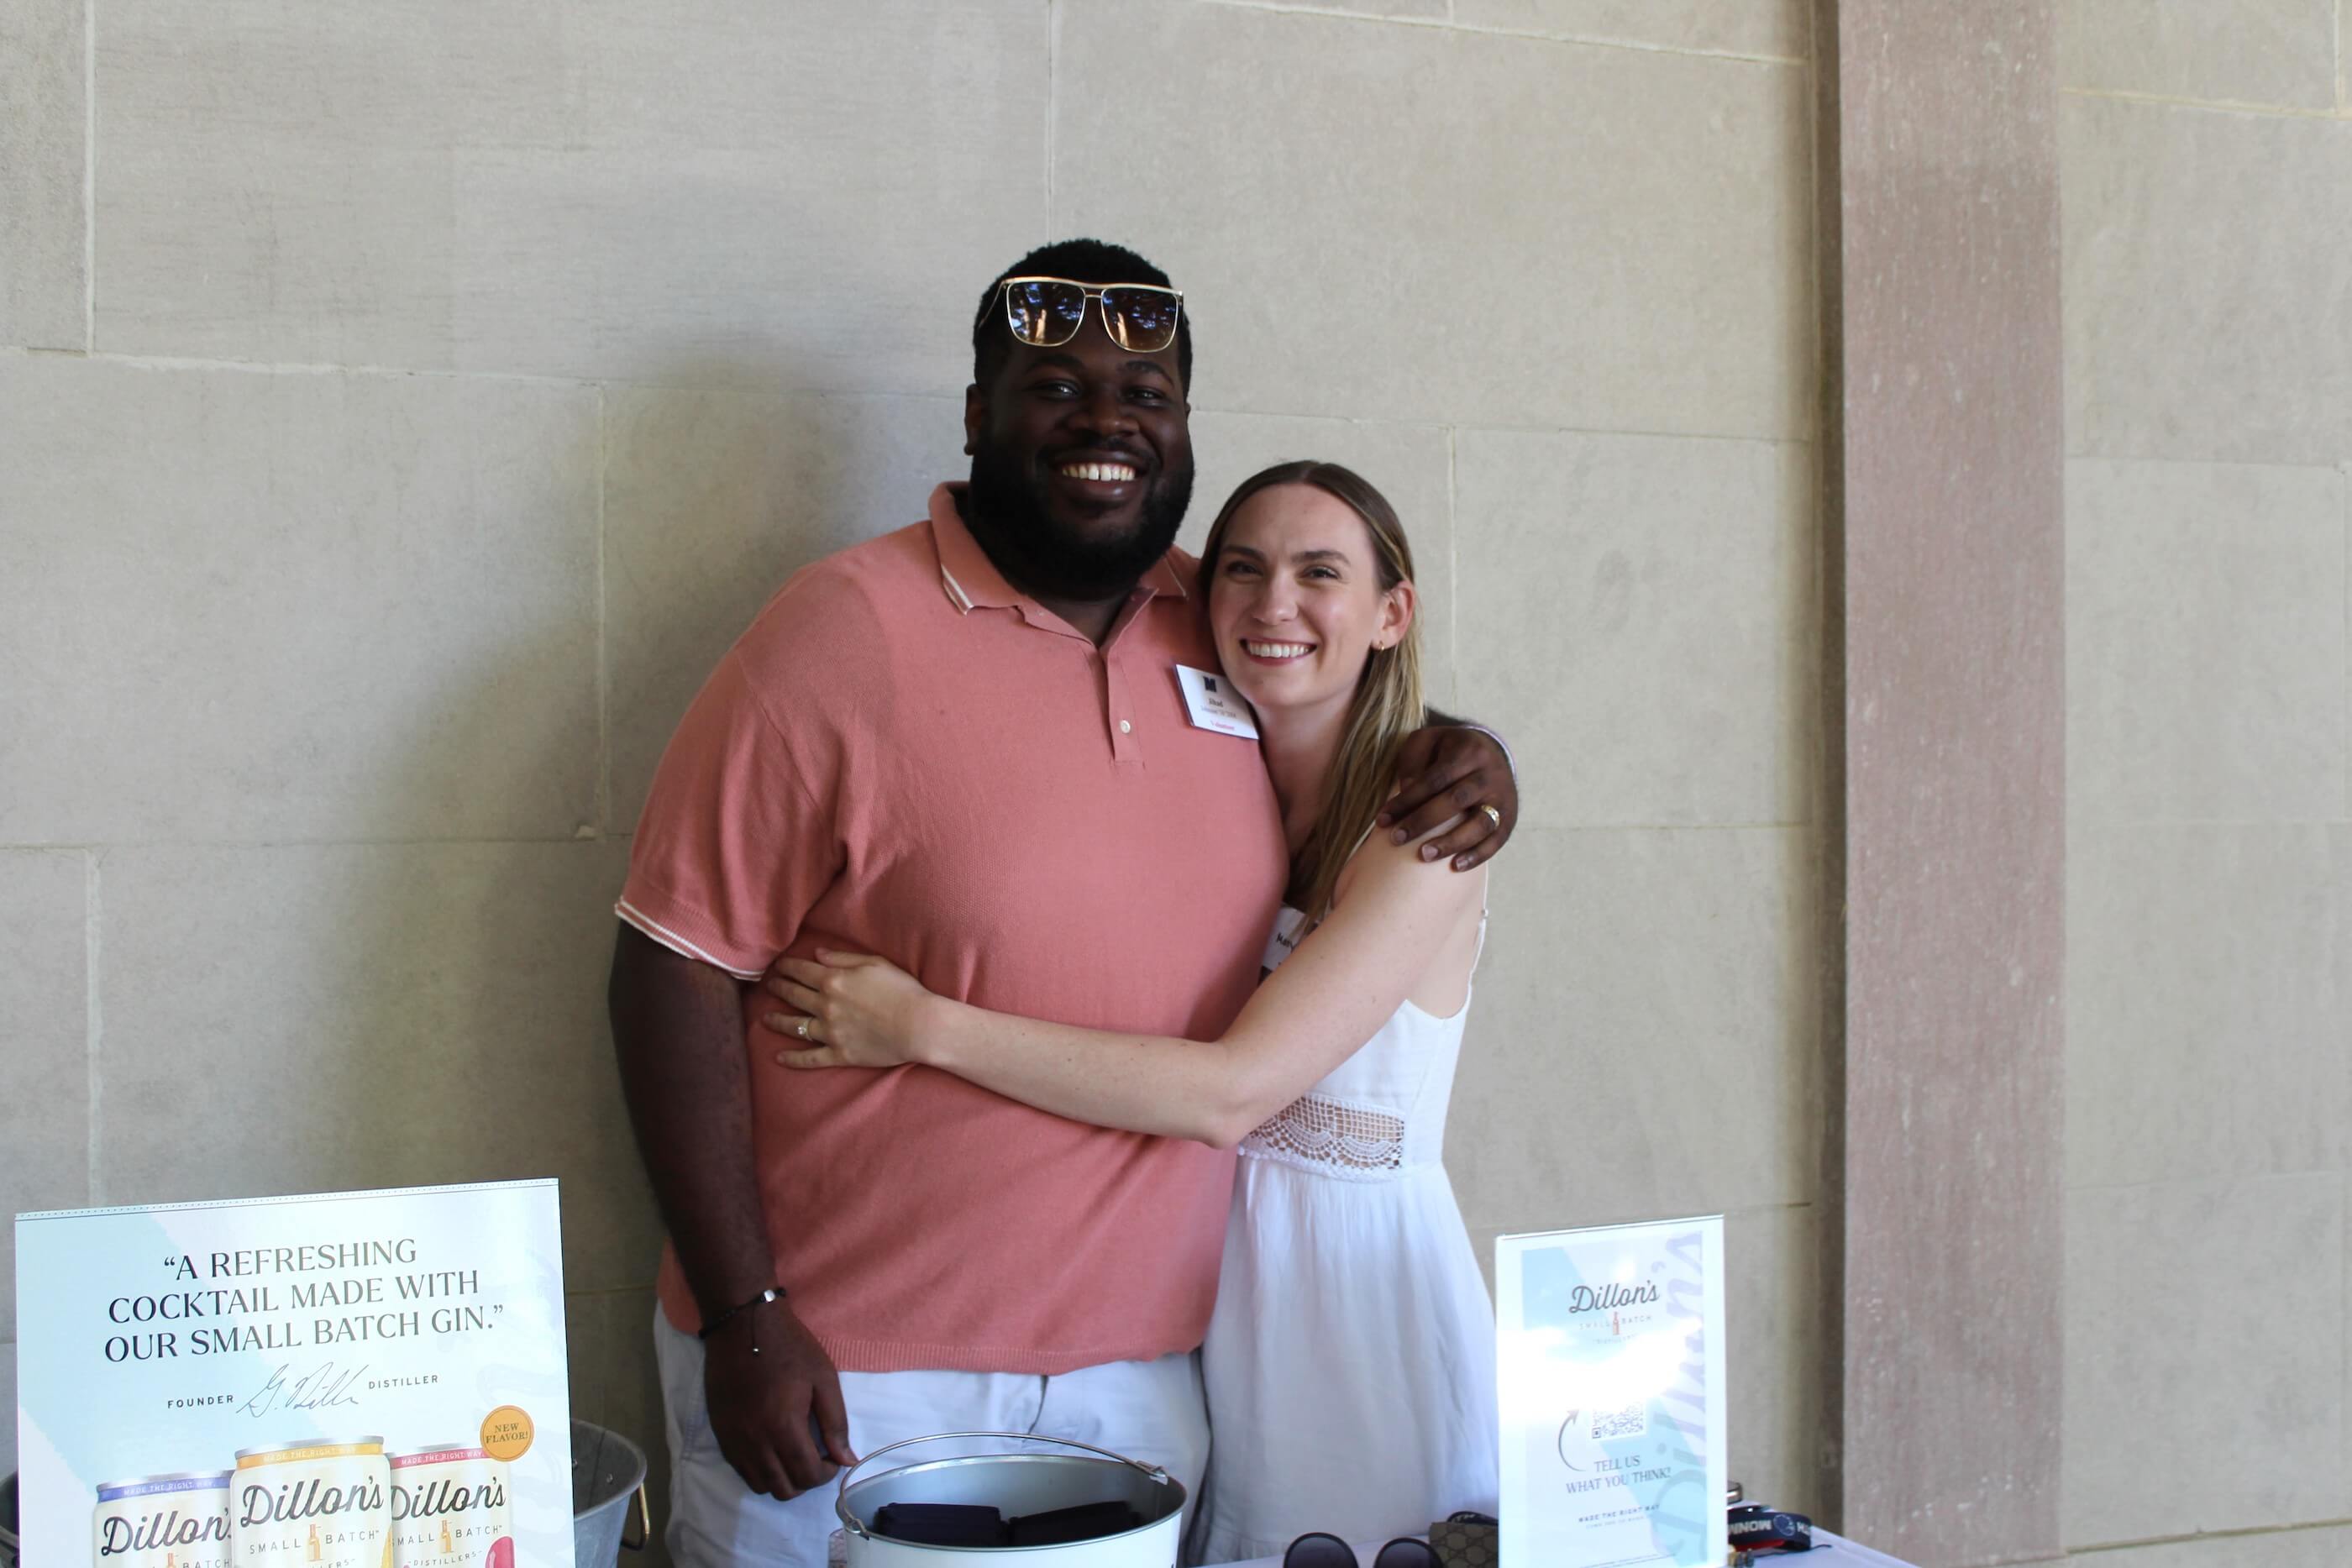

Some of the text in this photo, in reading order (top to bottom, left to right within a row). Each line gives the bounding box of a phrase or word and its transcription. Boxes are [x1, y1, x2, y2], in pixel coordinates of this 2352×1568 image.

[164, 1238, 417, 1281] “A REFRESHING
[108, 1270, 478, 1324] COCKTAIL MADE WITH
[1568, 1279, 1661, 1314] Dillon's
[105, 1304, 504, 1363] OUR SMALL BATCH GIN.”
[368, 1374, 438, 1390] DISTILLER
[167, 1394, 234, 1409] FOUNDER
[486, 1430, 529, 1445] FLAVOR!
[494, 1422, 520, 1434] NEW
[402, 1457, 423, 1466] MADE
[424, 1455, 439, 1463] THE
[441, 1452, 465, 1461] RIGHT
[1593, 1455, 1641, 1472] TELL US
[1566, 1467, 1672, 1494] WHAT YOU THINK?
[240, 1475, 385, 1529] Dillon's
[391, 1476, 507, 1521] Dillon's
[249, 1538, 302, 1555] SMALL
